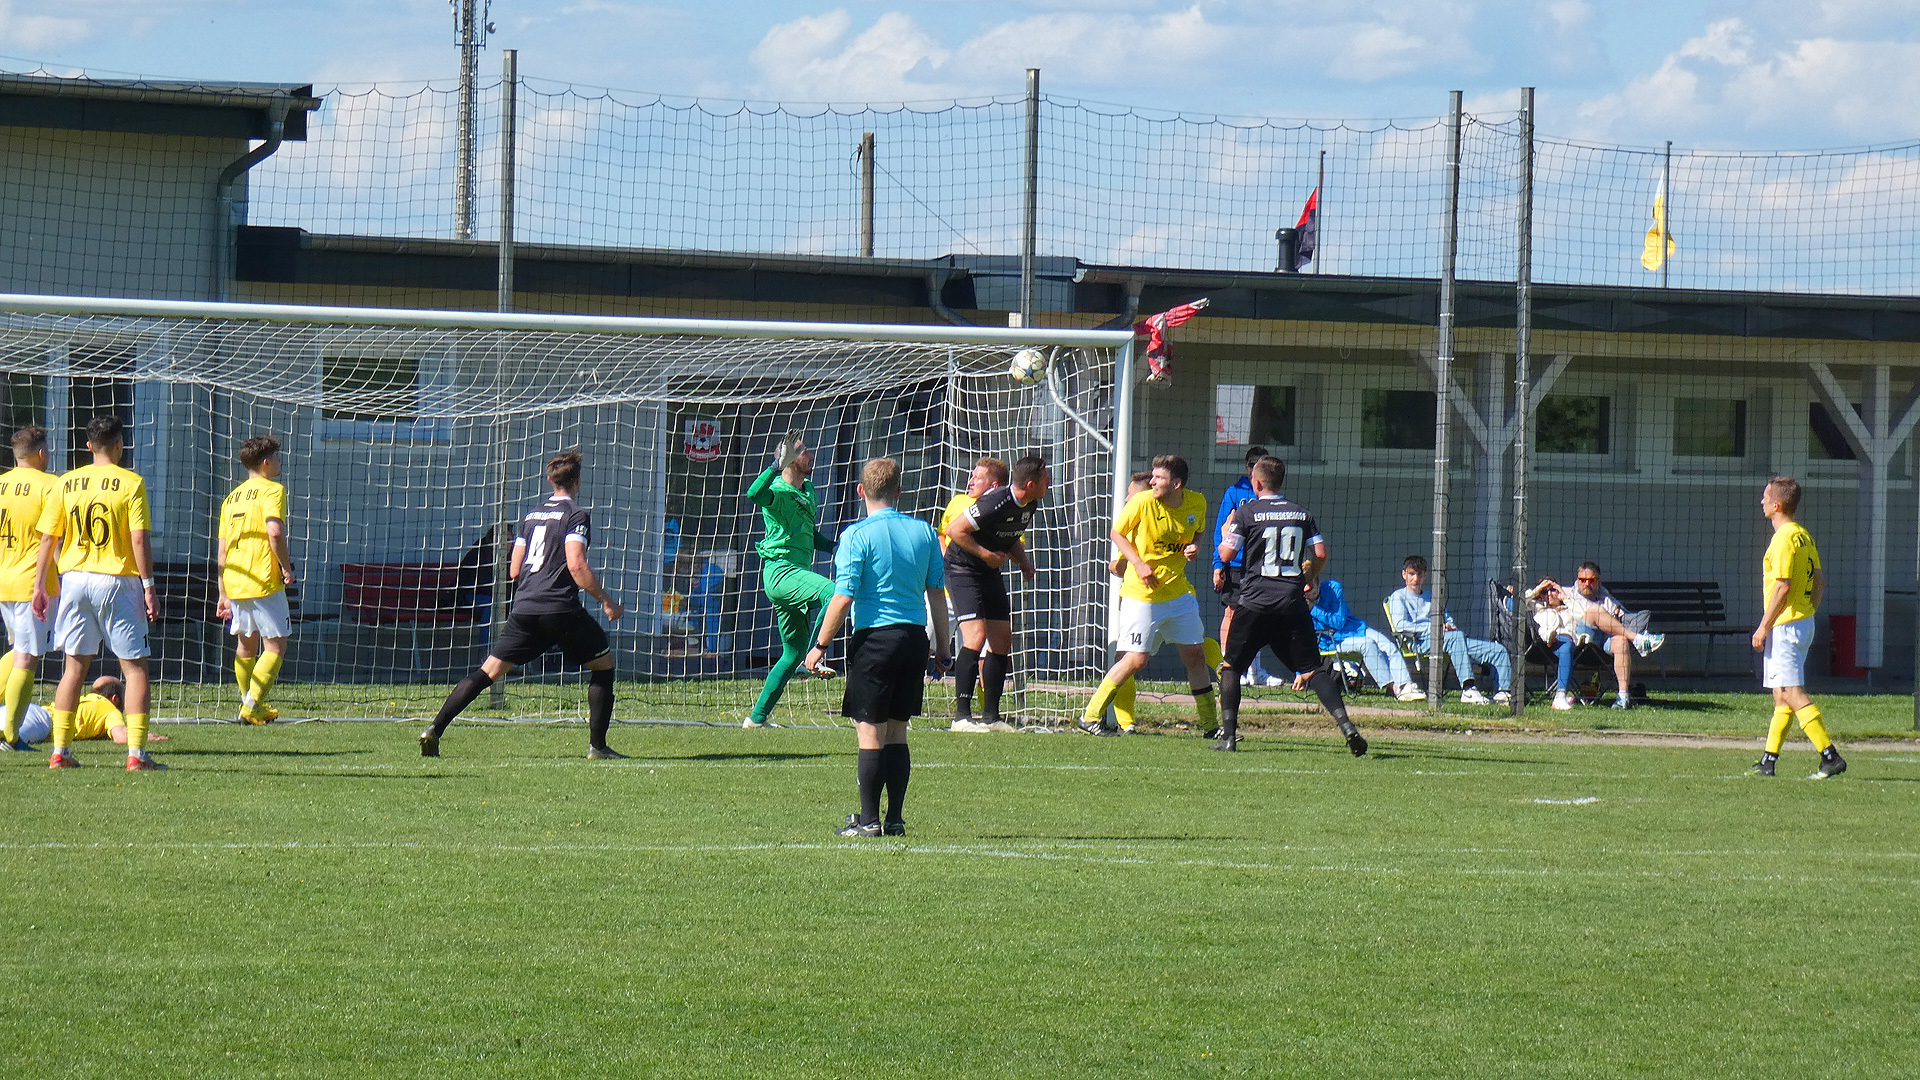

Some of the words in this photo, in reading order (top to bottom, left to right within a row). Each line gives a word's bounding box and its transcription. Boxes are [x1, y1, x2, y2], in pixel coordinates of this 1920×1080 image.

[15, 483, 31, 496] 09
[65, 477, 90, 494] NFV
[101, 477, 120, 492] 09
[970, 503, 981, 518] LSV
[1253, 511, 1266, 522] LSV
[0, 508, 17, 549] 4
[70, 502, 111, 549] 16
[230, 512, 247, 550] 7
[525, 525, 547, 573] 4
[1261, 526, 1304, 577] 19
[1130, 632, 1142, 646] 14
